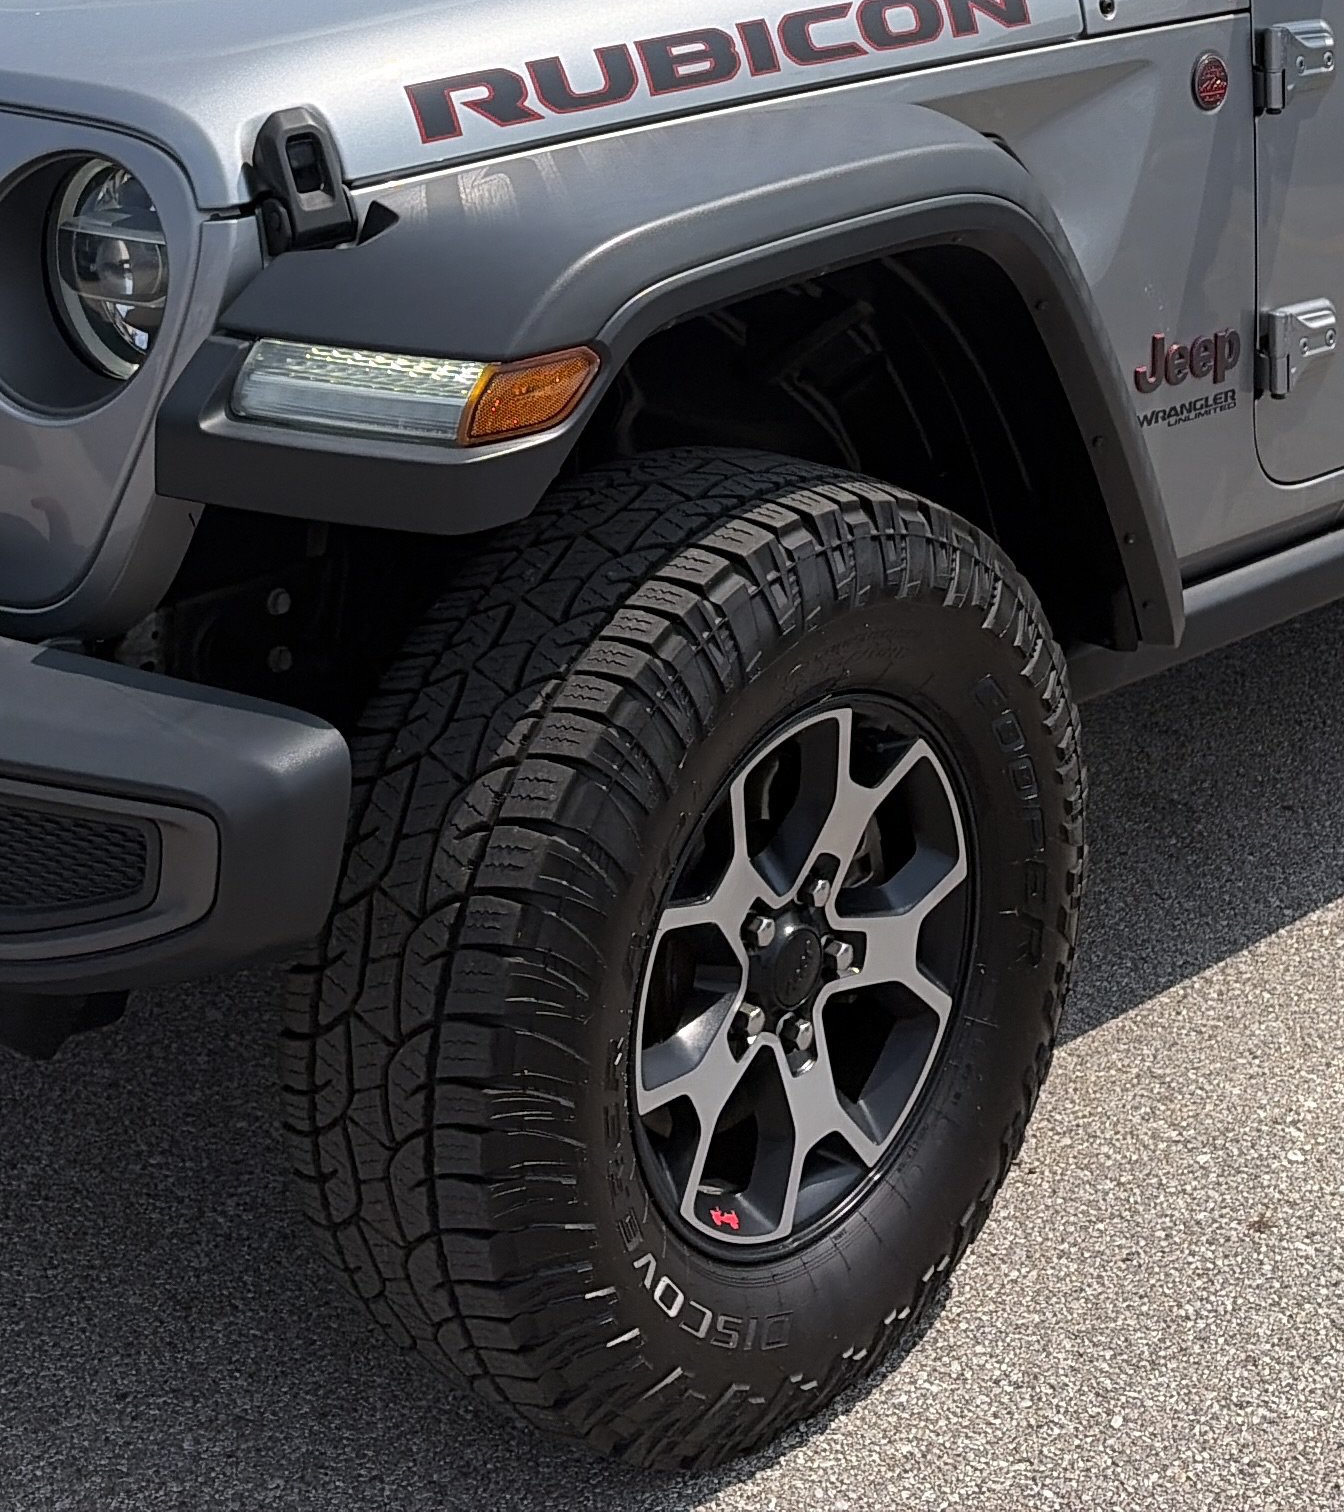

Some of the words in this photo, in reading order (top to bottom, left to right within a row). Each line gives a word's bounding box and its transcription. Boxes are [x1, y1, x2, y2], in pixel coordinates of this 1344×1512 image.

[1134, 328, 1241, 394] Jeep
[1137, 389, 1236, 428] WRANGLER
[1168, 402, 1237, 427] UNLIMITED
